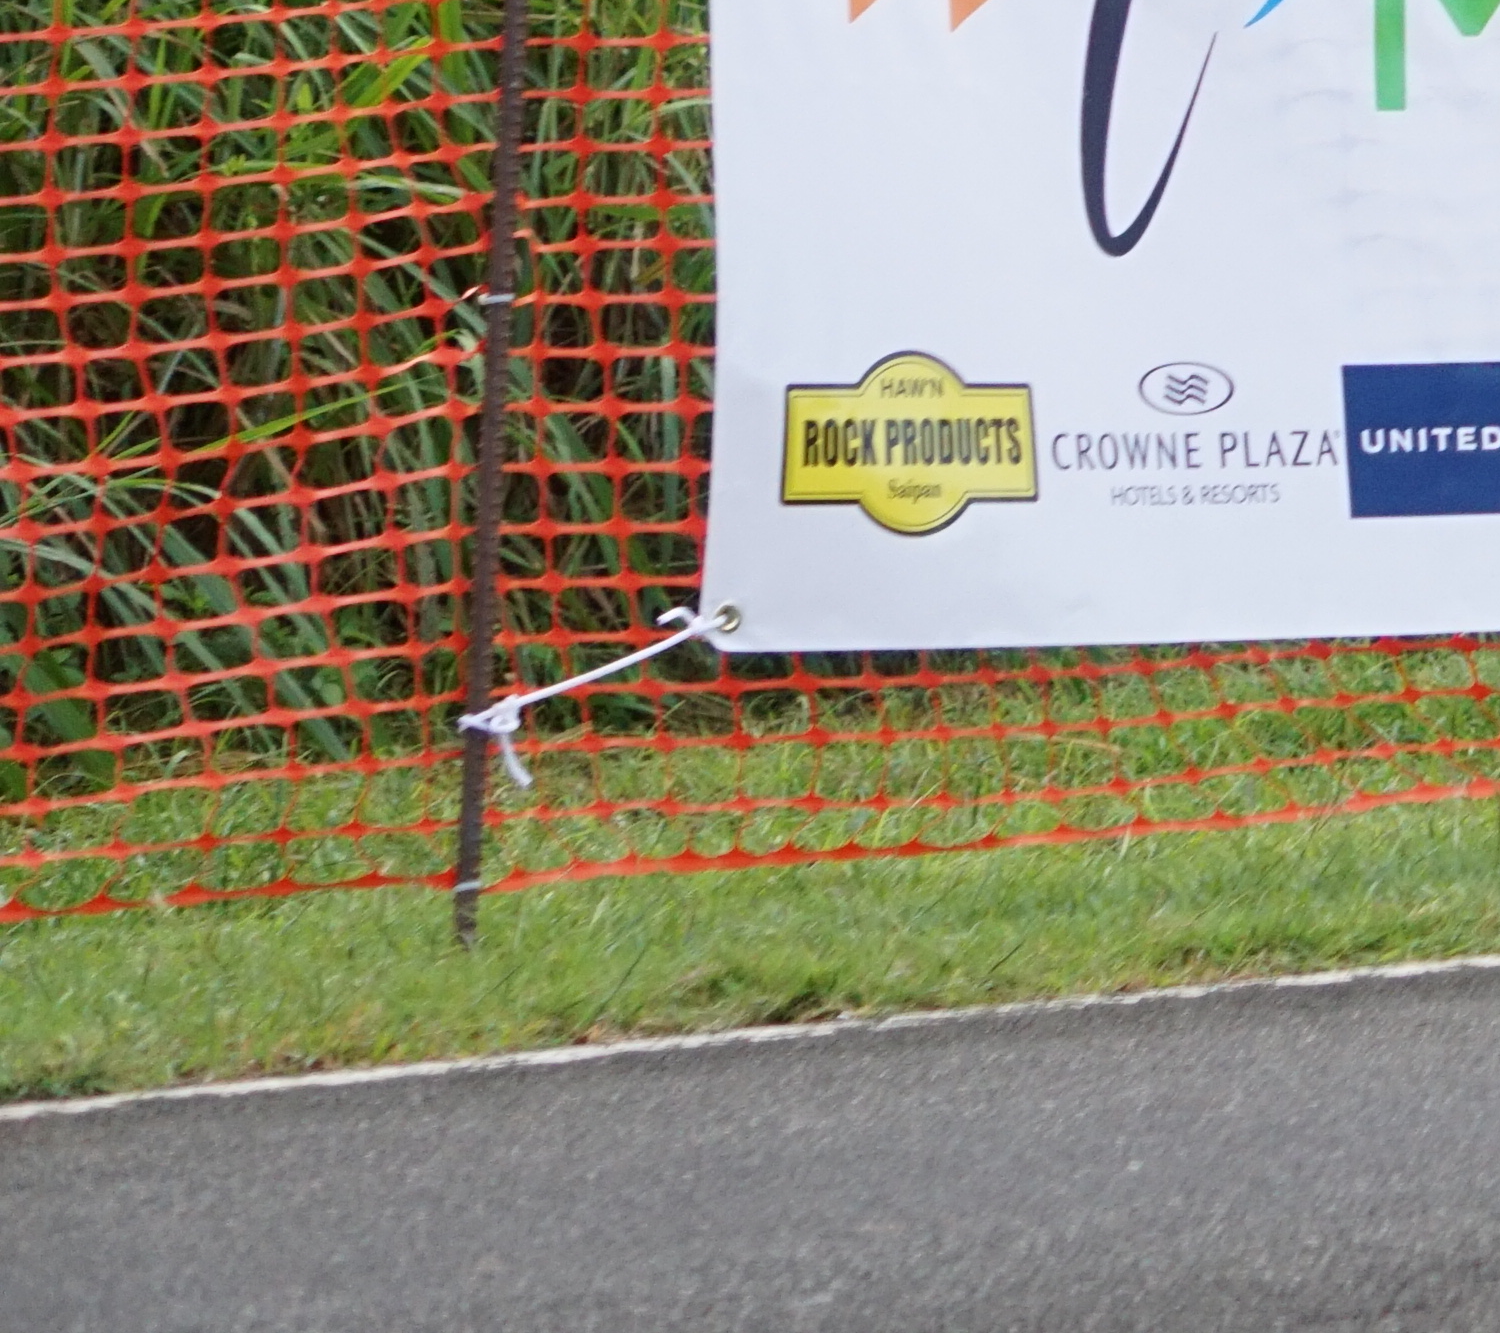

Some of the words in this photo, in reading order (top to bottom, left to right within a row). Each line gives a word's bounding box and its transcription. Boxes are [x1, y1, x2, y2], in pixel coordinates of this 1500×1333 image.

[802, 417, 876, 468] ROCK
[884, 416, 1022, 467] PRODUCTS
[1051, 431, 1203, 472] CROWNE
[1218, 429, 1339, 469] PLAZA
[1110, 485, 1178, 507] HOTELS
[1200, 483, 1281, 505] RESORTS
